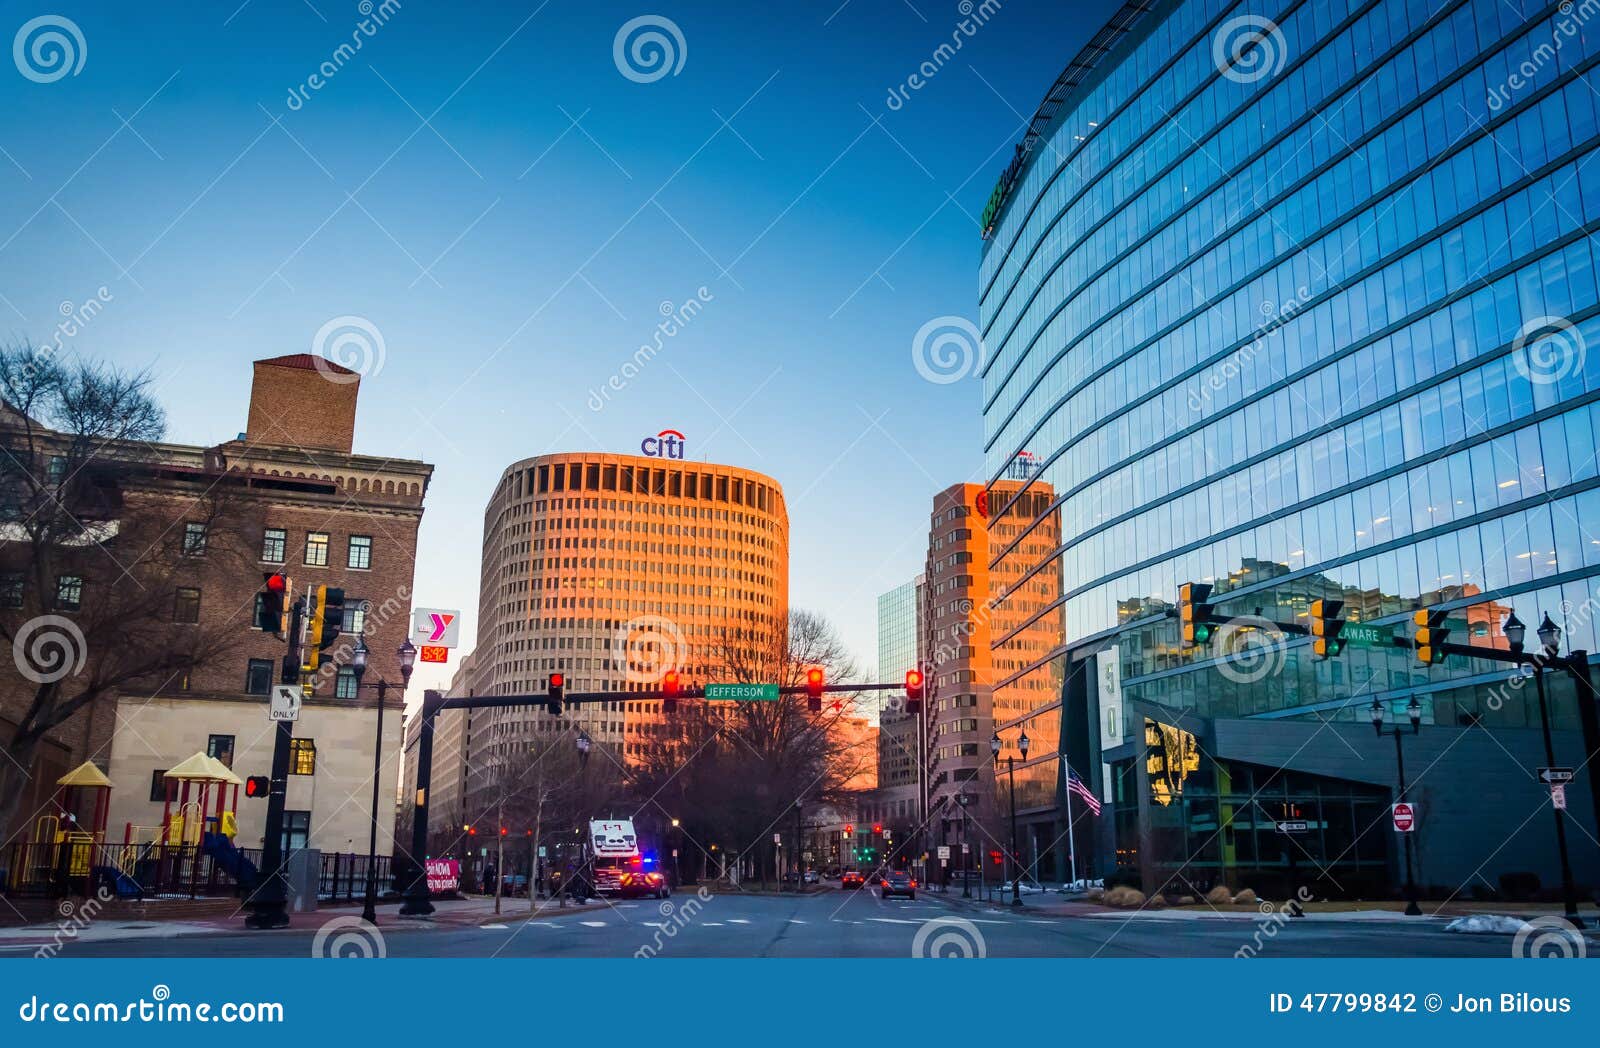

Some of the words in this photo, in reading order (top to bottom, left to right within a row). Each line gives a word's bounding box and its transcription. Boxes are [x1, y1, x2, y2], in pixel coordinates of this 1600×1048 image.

[641, 430, 685, 459] citi
[1338, 627, 1379, 642] LAWARE
[706, 687, 763, 697] JEFFERSON
